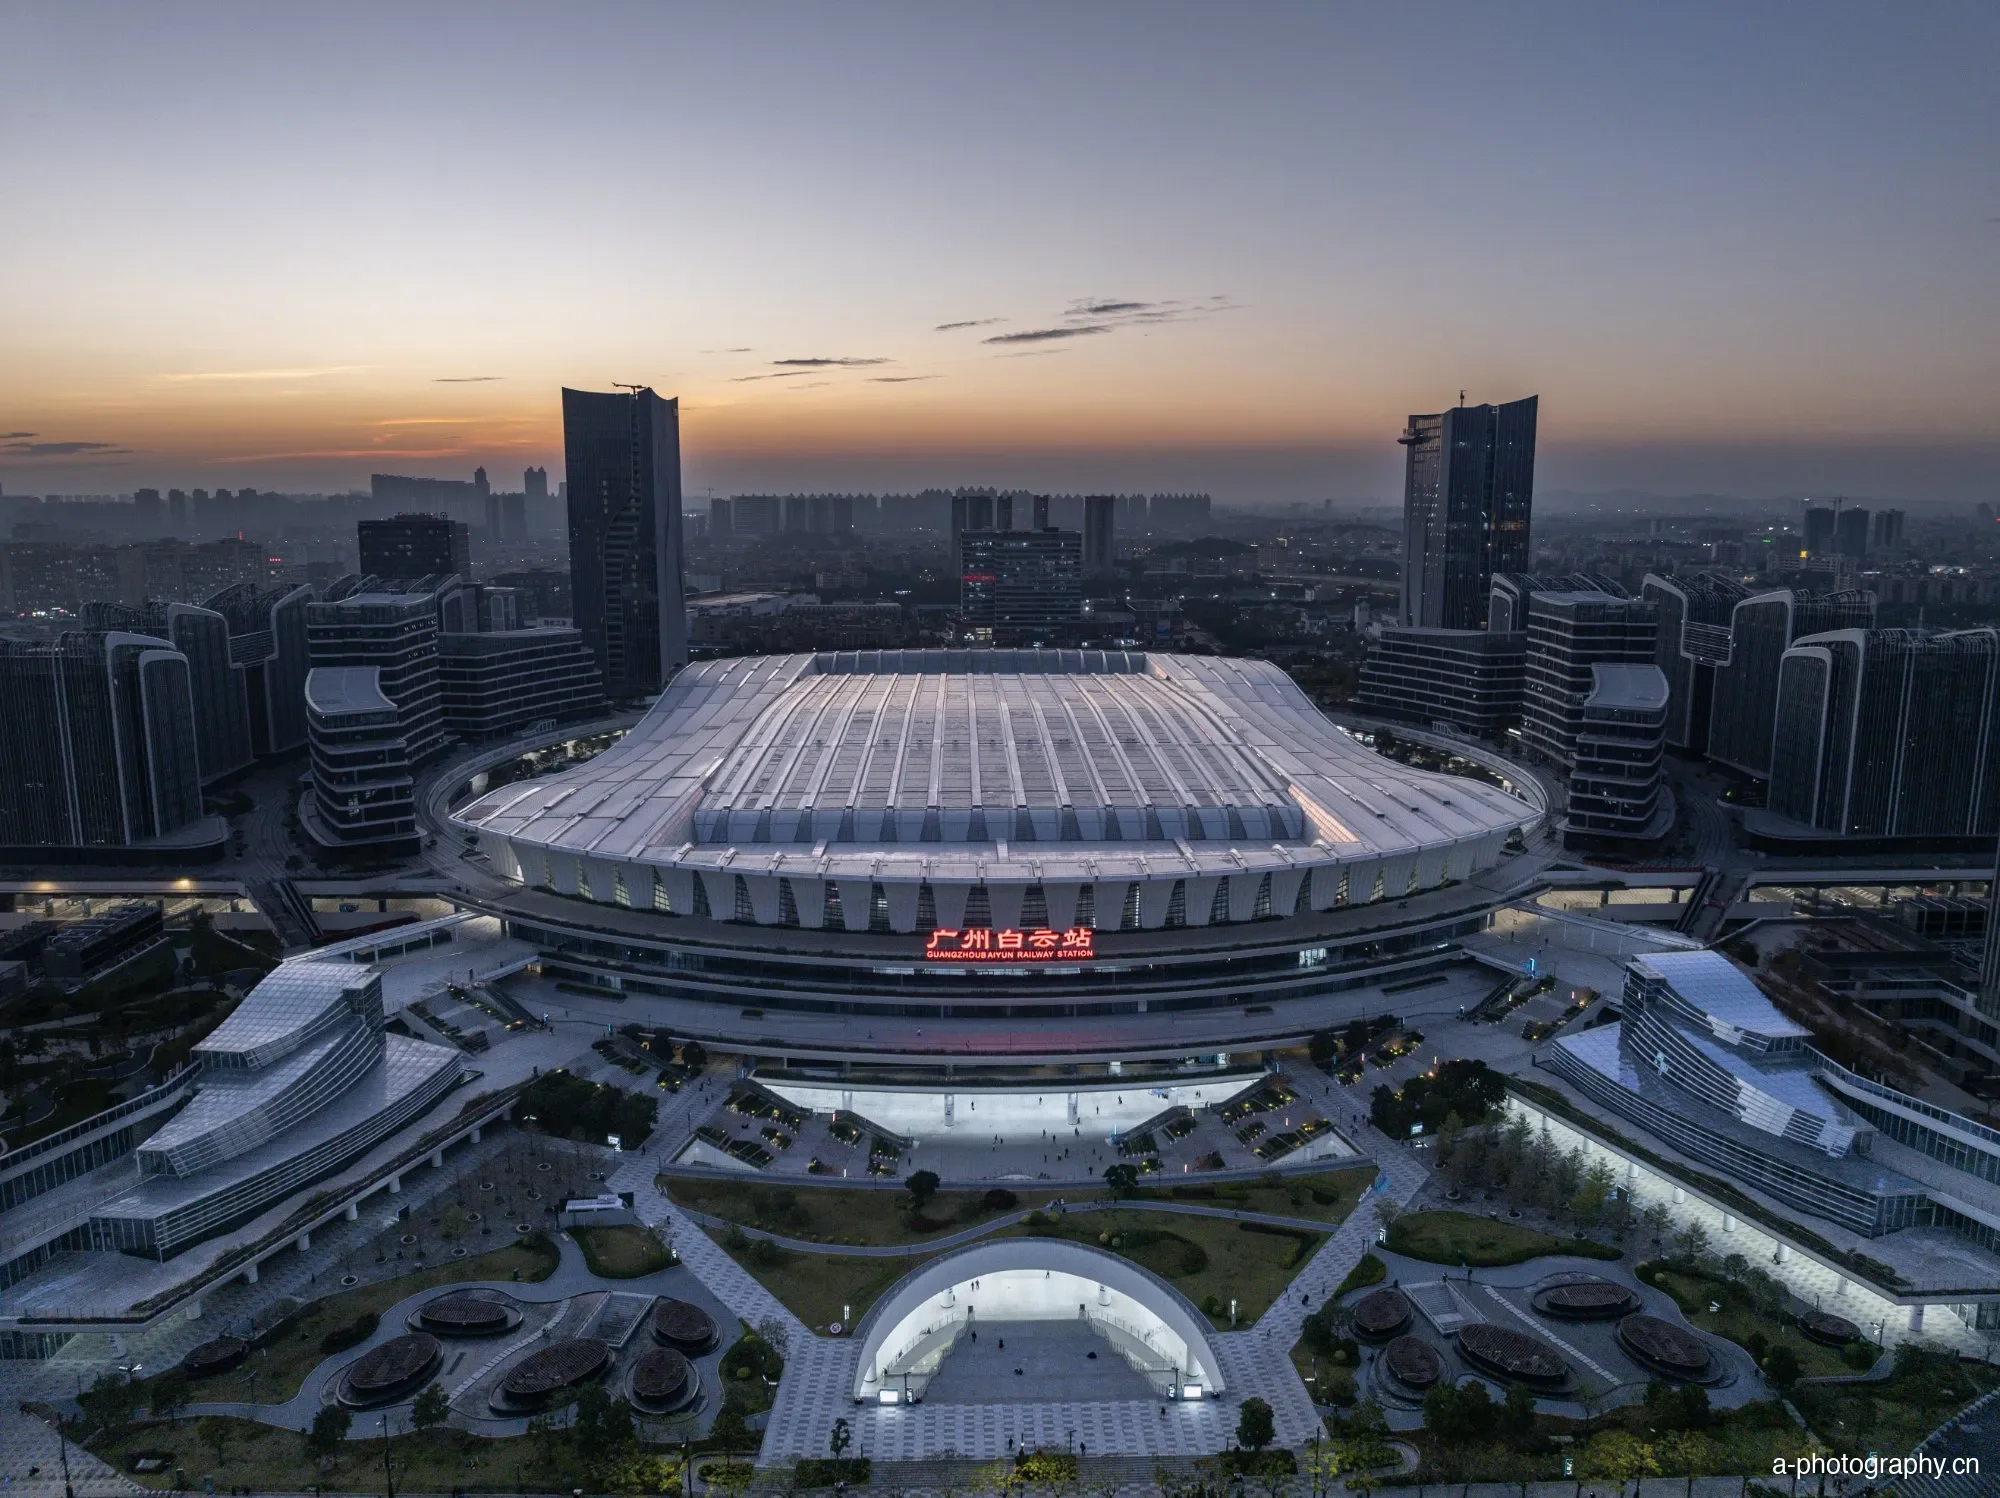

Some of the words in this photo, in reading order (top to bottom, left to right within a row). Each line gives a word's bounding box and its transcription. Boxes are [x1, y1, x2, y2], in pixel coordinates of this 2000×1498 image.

[926, 928, 1093, 949] 广州白云站
[1057, 950, 1093, 958] STATION
